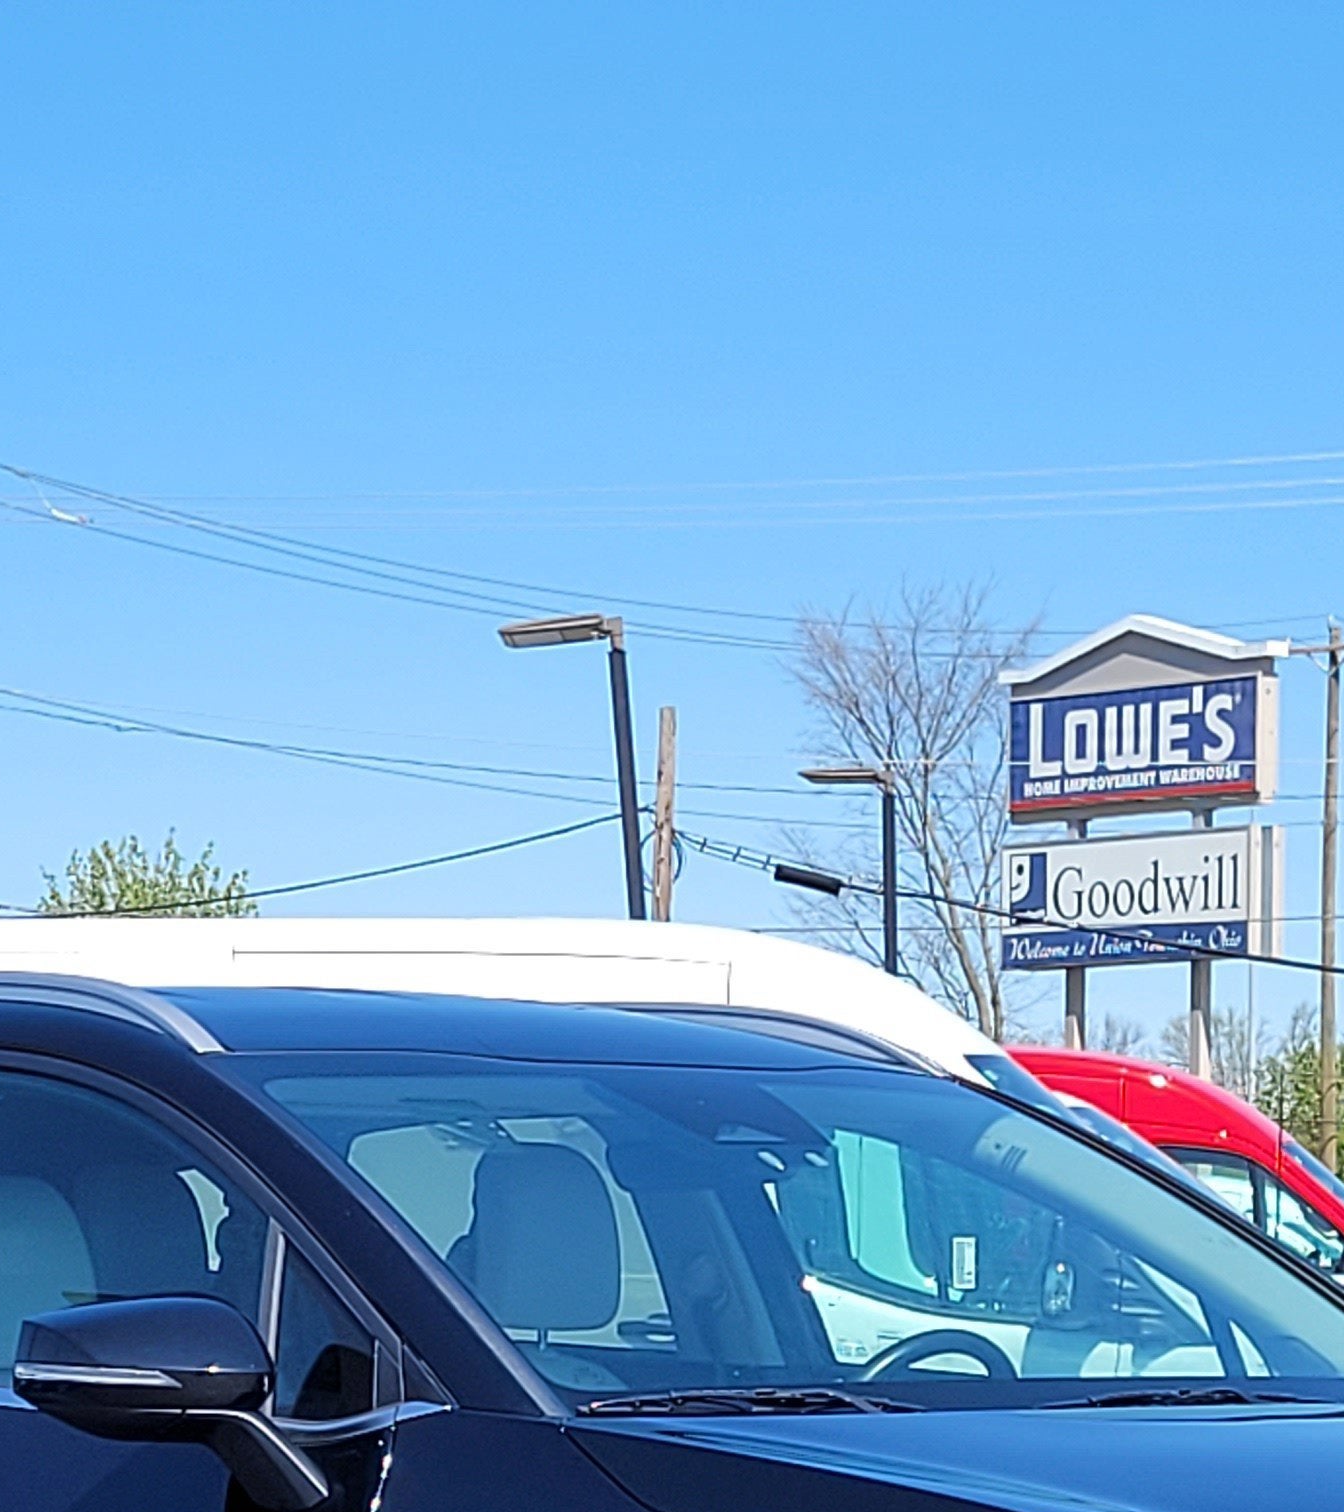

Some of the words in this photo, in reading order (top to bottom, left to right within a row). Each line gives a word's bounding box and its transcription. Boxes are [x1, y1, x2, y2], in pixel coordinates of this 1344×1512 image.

[1028, 685, 1236, 779] LOWE'S
[1023, 779, 1061, 798] HOME
[1063, 771, 1157, 794] IMPROVEMENT
[1159, 763, 1241, 785] WAREHOUSE
[1052, 852, 1241, 921] Goodwill
[1009, 937, 1070, 961] Welcome
[1073, 940, 1086, 956] to
[1208, 924, 1243, 950] Ohio
